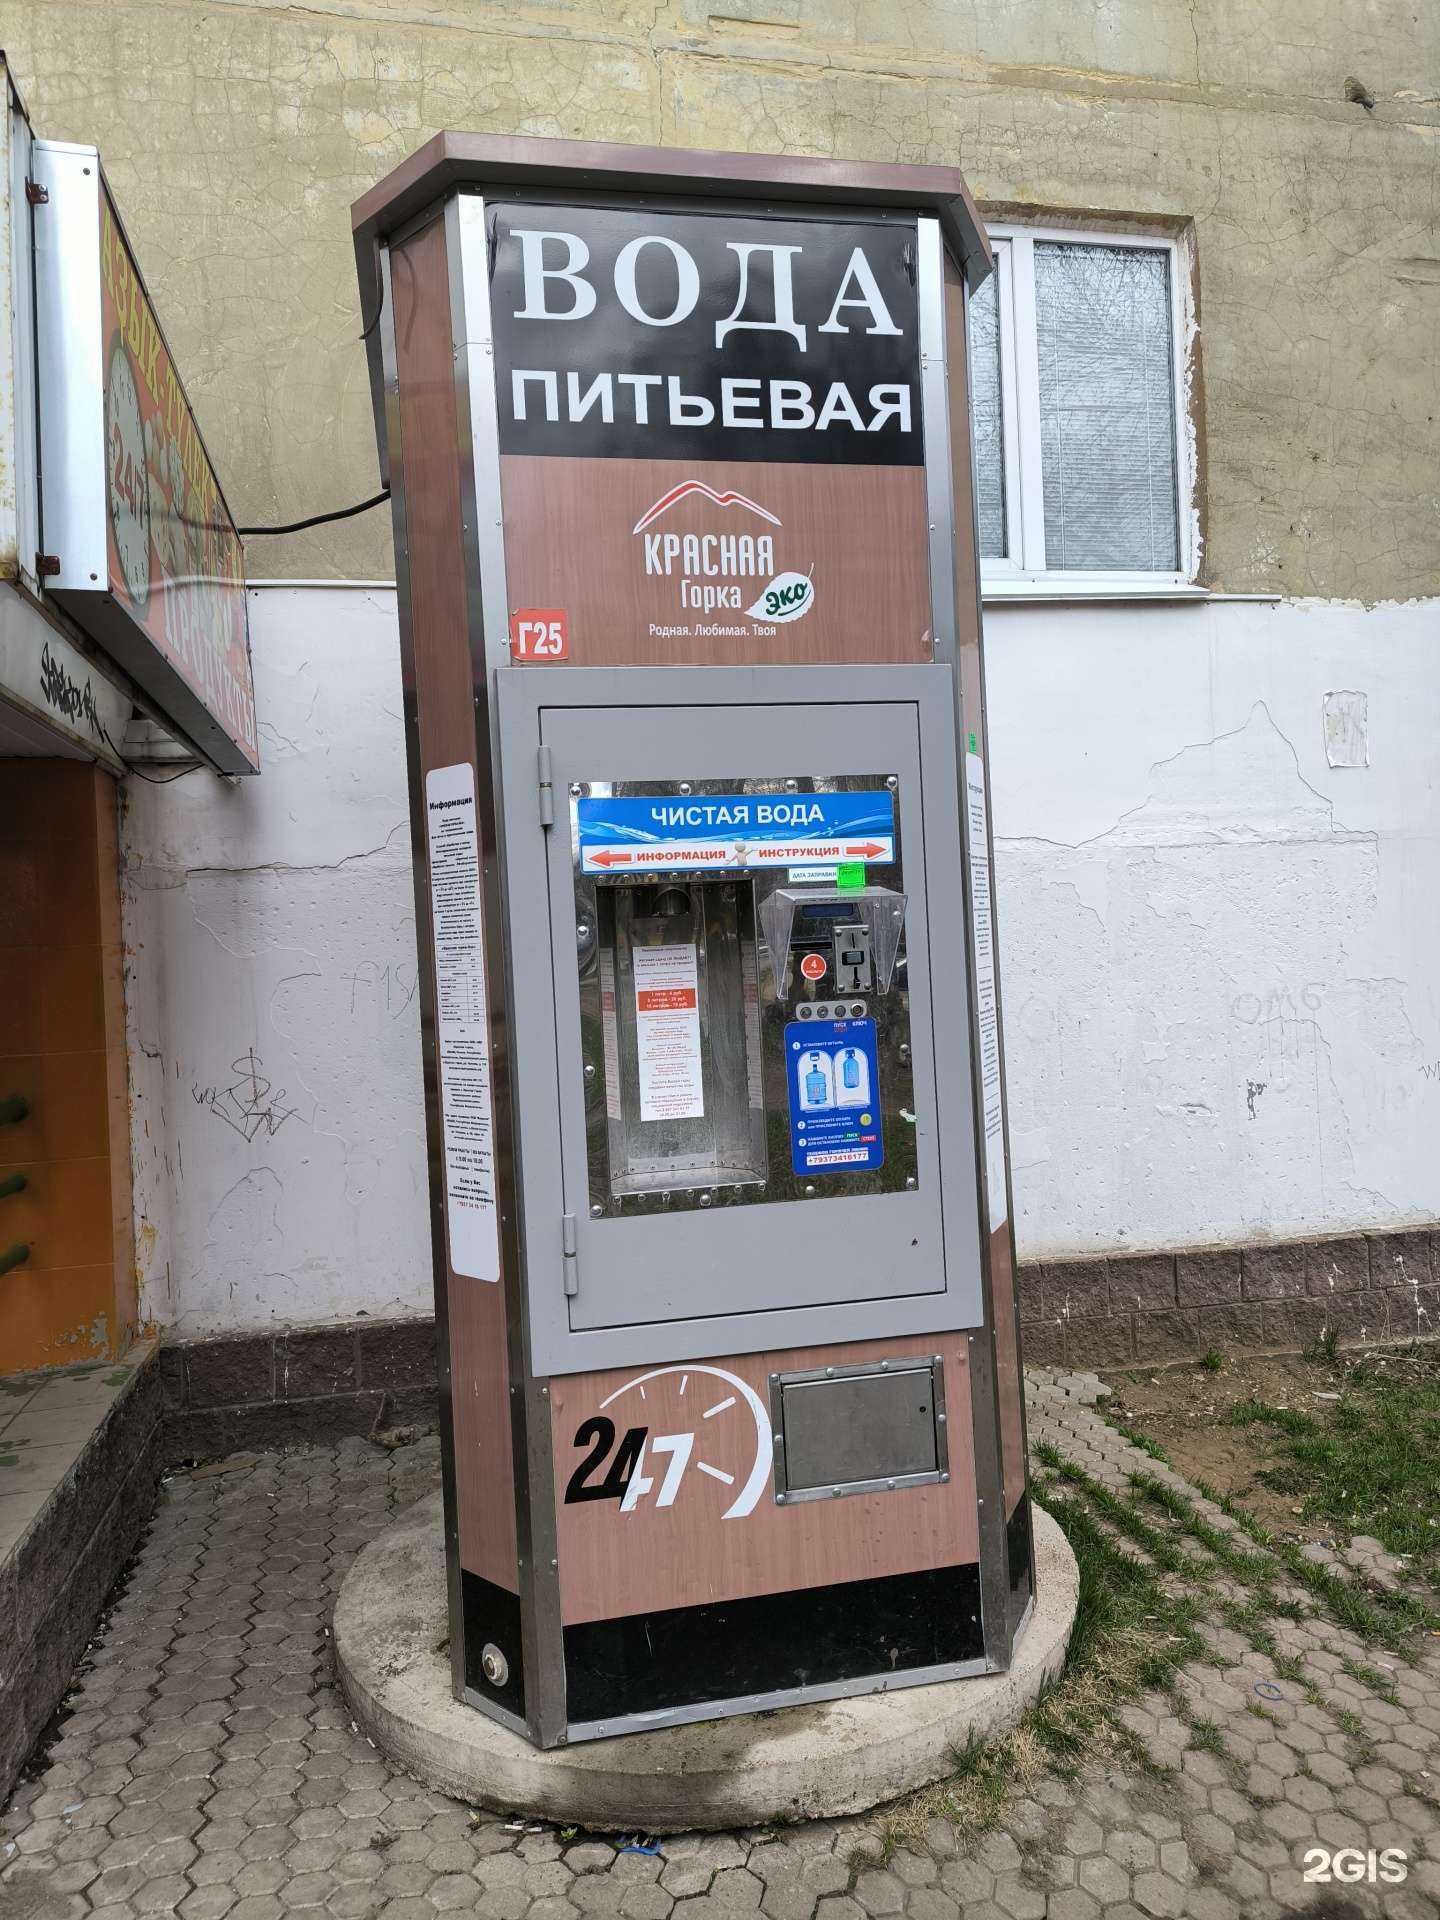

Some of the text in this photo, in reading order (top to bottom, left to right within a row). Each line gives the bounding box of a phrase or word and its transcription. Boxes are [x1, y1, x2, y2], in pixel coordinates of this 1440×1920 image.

[510, 230, 903, 352] ВОДА
[512, 369, 912, 432] ПИТЬЕВАЯ
[644, 533, 774, 577] КРАСНАЯ
[681, 579, 742, 613] Горка
[518, 621, 563, 655] Г25
[649, 623, 777, 637] Родная. Любимая. Твоя
[429, 797, 473, 811] Информация
[651, 803, 824, 827] ЧИСТАЯ ВОДА
[636, 850, 726, 862] ИНФОРМАЦИЯ
[758, 846, 840, 858] ИНСТРУКЦИЯ
